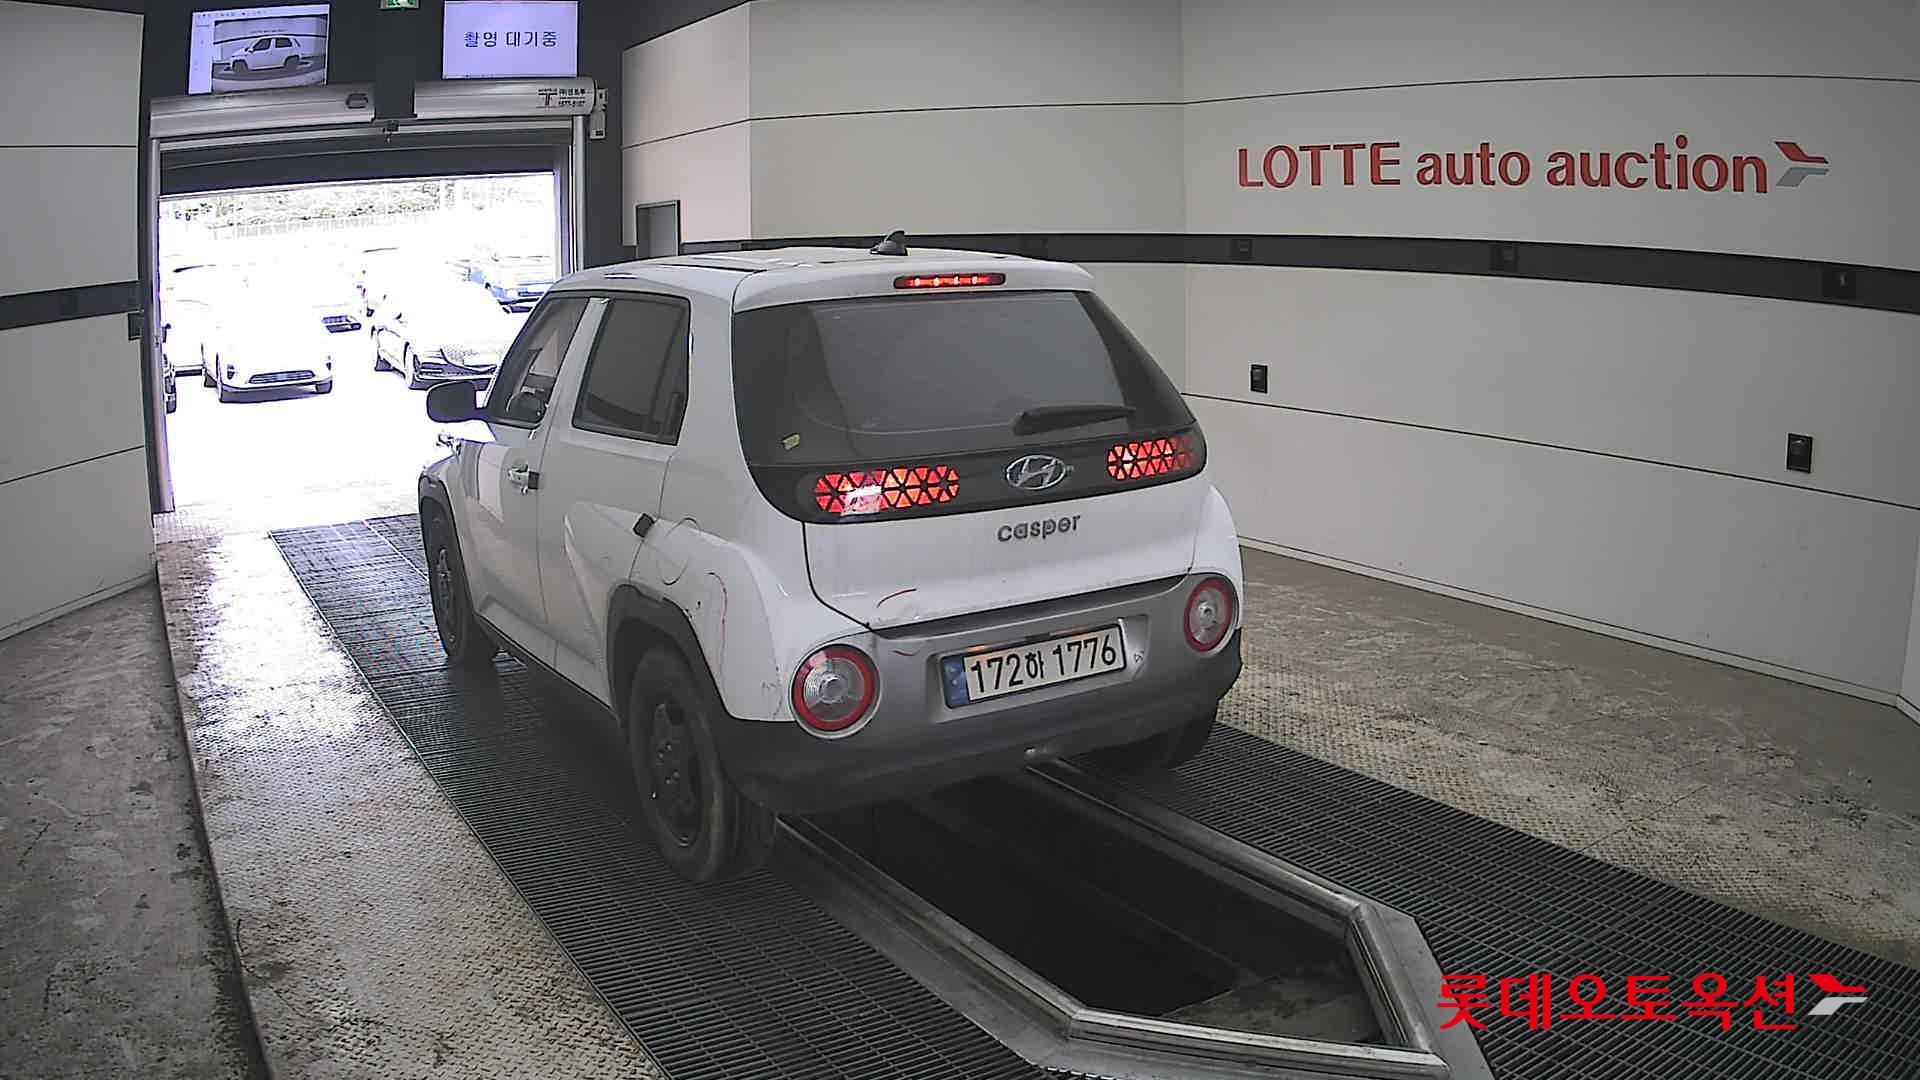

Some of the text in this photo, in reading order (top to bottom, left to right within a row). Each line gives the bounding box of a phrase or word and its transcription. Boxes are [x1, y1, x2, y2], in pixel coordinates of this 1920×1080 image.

[464, 31, 558, 48] 촬영 대기중
[1238, 135, 1768, 194] LOTTE auto auction
[998, 514, 1081, 542] casper
[971, 634, 1117, 693] 172하 1776
